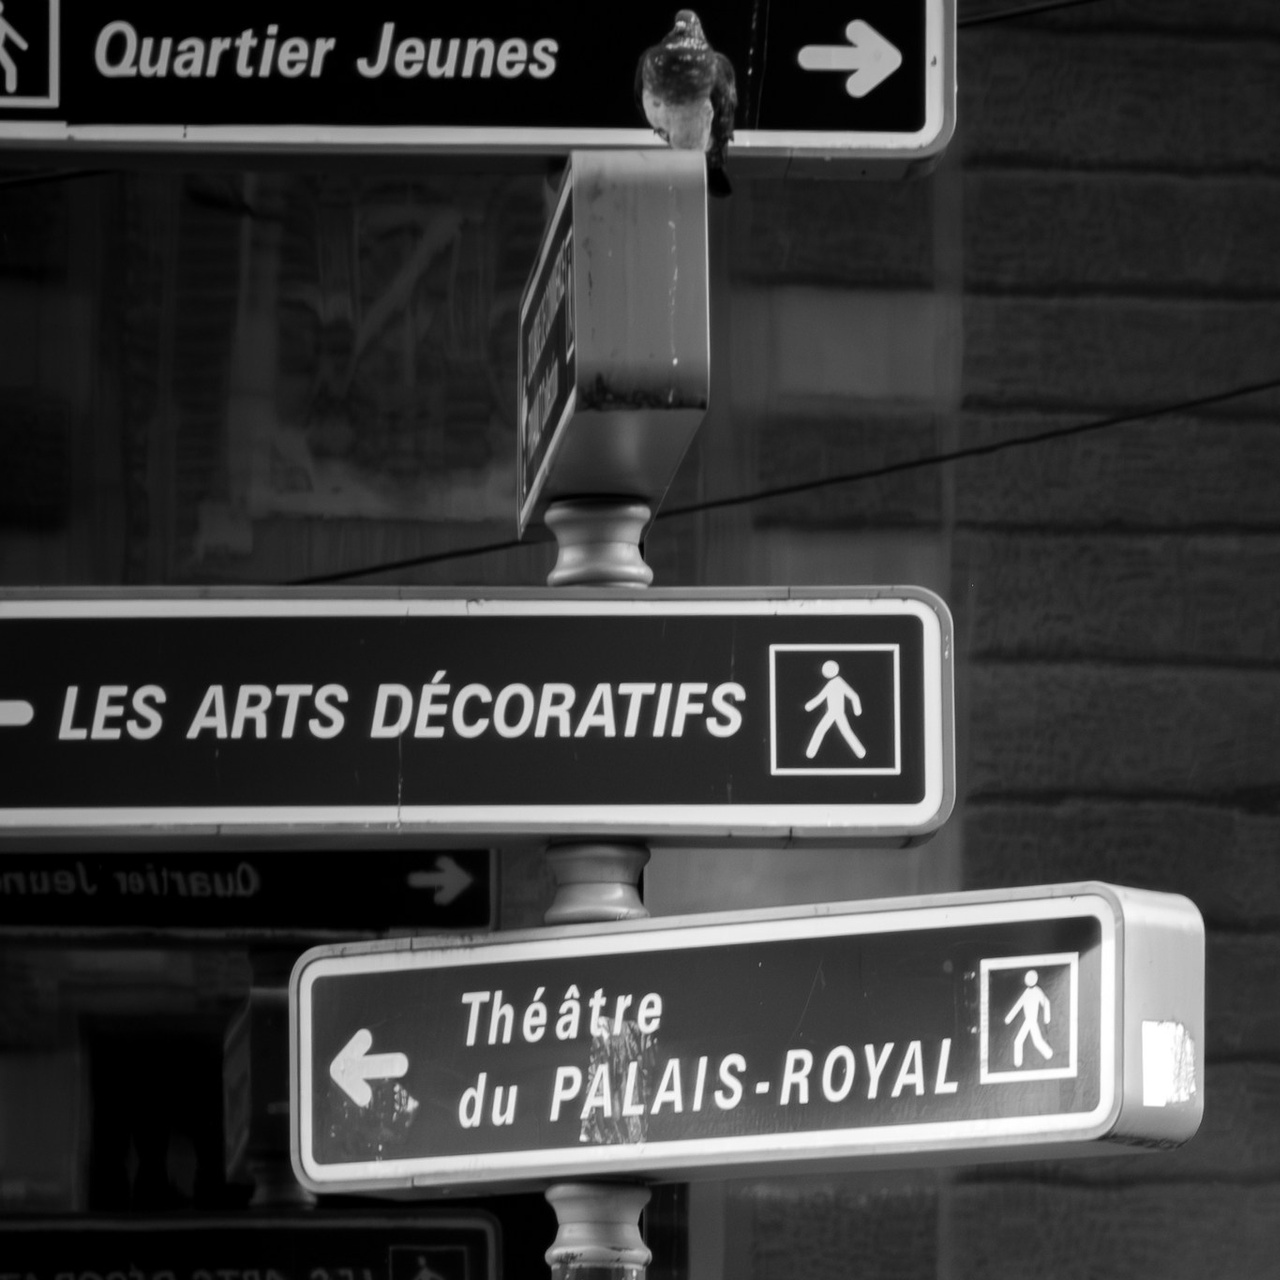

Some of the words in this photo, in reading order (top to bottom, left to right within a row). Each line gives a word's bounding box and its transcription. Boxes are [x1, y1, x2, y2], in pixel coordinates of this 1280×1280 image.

[95, 21, 335, 78] Quartier
[356, 23, 559, 79] Jeunes
[59, 685, 166, 740] LES
[187, 684, 349, 739] ARTS
[371, 671, 747, 738] DÉCORATIFS
[461, 984, 663, 1047] Théâtre
[459, 1073, 518, 1128] du
[550, 1038, 959, 1123] PALAIS-ROYAL
